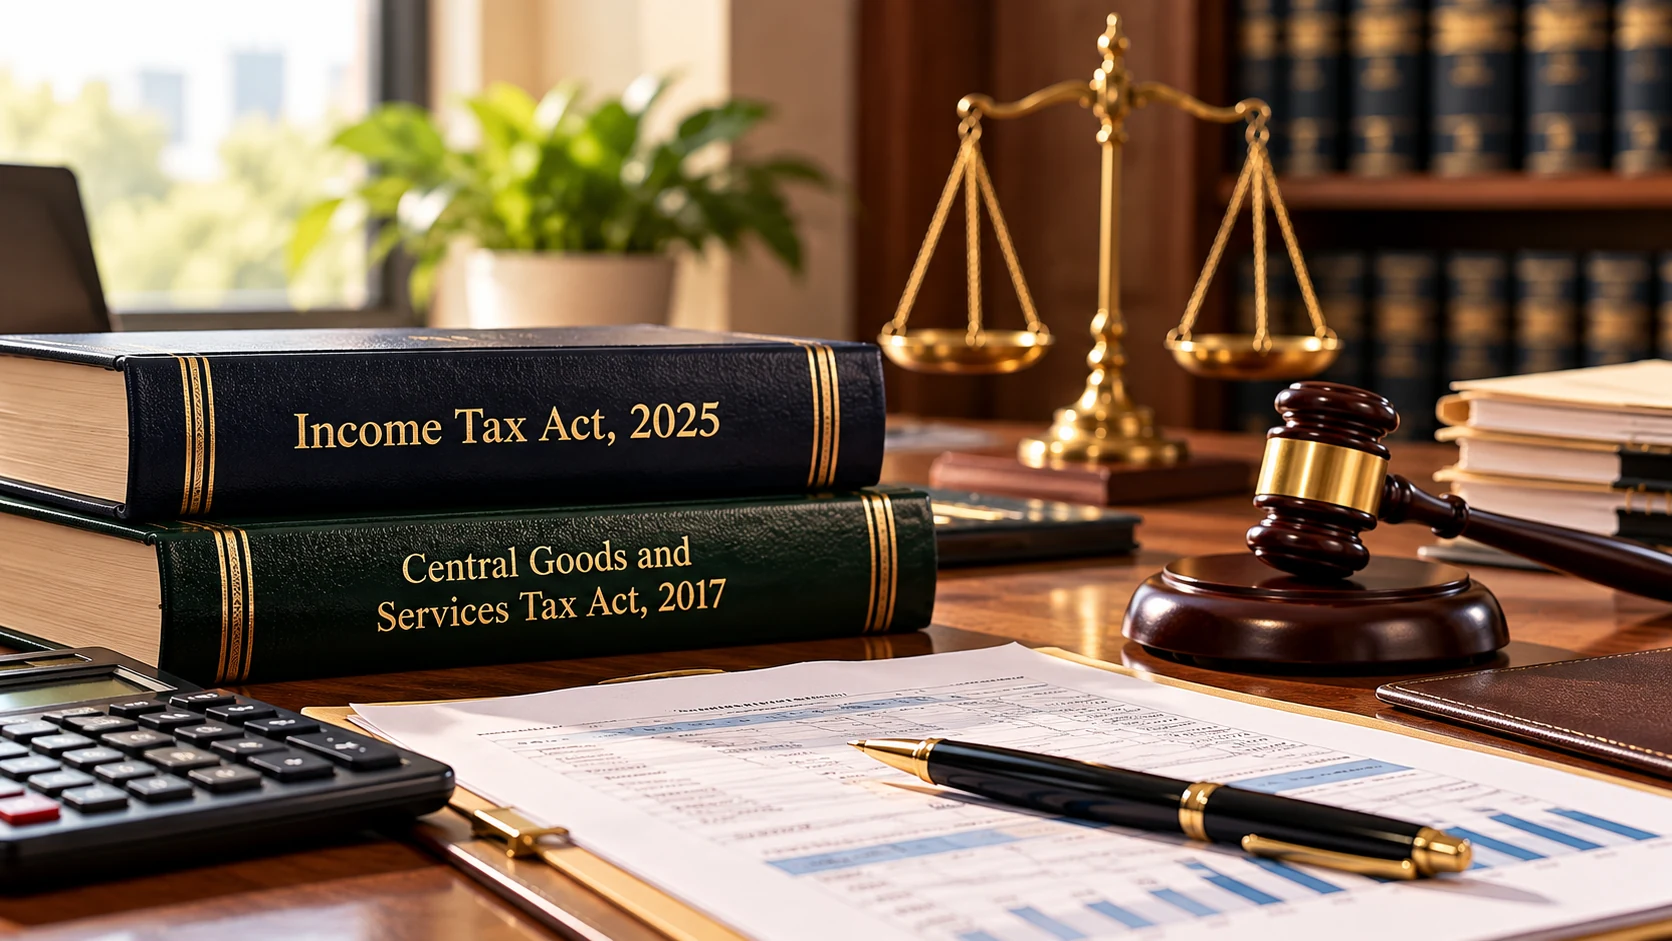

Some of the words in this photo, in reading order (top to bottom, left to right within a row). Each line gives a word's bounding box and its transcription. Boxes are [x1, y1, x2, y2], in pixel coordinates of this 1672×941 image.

[294, 413, 442, 449] Income
[454, 407, 527, 444] Tax
[539, 406, 616, 447] Act,
[630, 401, 720, 439] 2025
[402, 546, 519, 584] Central
[529, 539, 628, 576] Goods
[637, 536, 691, 569] and
[377, 596, 509, 632] Services
[519, 590, 577, 621] Tax
[585, 586, 648, 619] Act,
[658, 578, 727, 612] 2017
